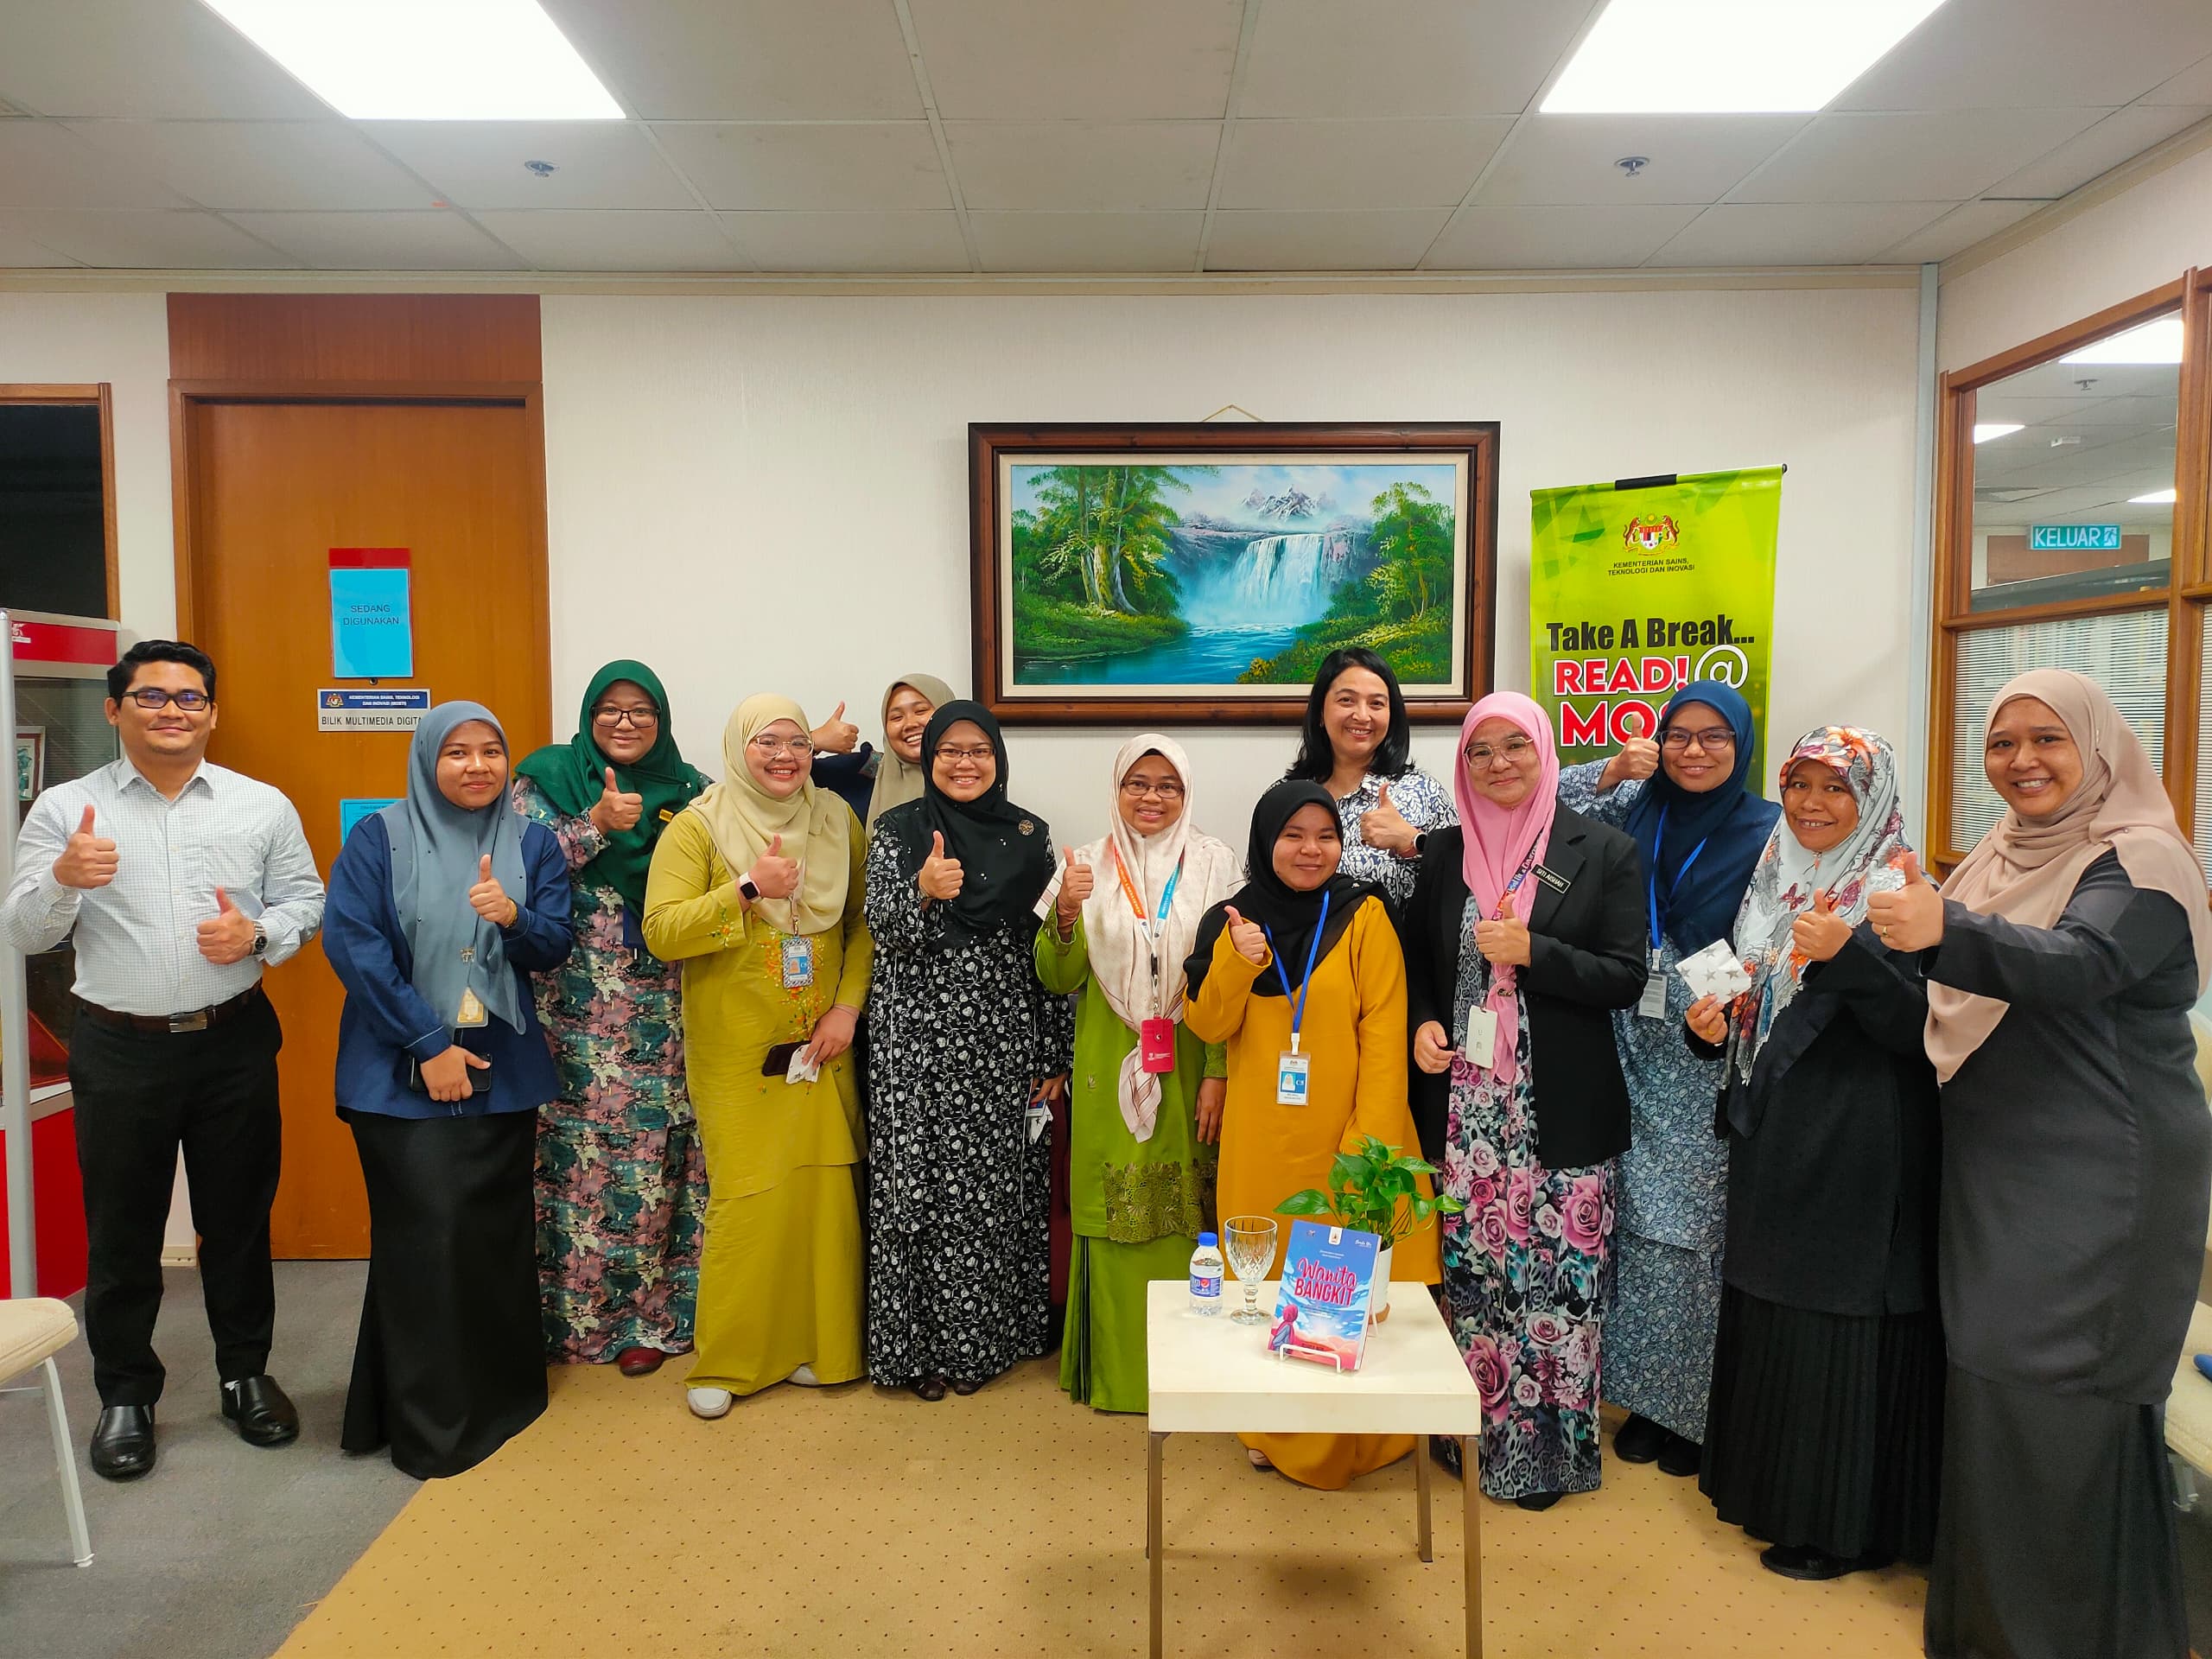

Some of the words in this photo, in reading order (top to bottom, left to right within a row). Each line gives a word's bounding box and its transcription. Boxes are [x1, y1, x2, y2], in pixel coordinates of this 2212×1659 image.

[2035, 527, 2101, 547] KELUAR
[1608, 567, 1648, 576] TEKNOLOGI
[1667, 564, 1695, 573] INOVASI
[1613, 559, 1664, 569] KEMENTERIAN
[351, 604, 391, 613] SEDANG
[343, 616, 399, 626] DIGUNAKAN
[1547, 622, 1614, 652] Take
[1620, 619, 1640, 649] A
[1647, 613, 1755, 648] Break...
[321, 716, 342, 725] BILIK
[346, 716, 394, 726] MULTIMEDIA
[397, 716, 422, 726] DIGIT
[1560, 699, 1670, 747] MO
[1297, 1257, 1357, 1287] Wanita
[1294, 1277, 1355, 1307] BANGKIT
